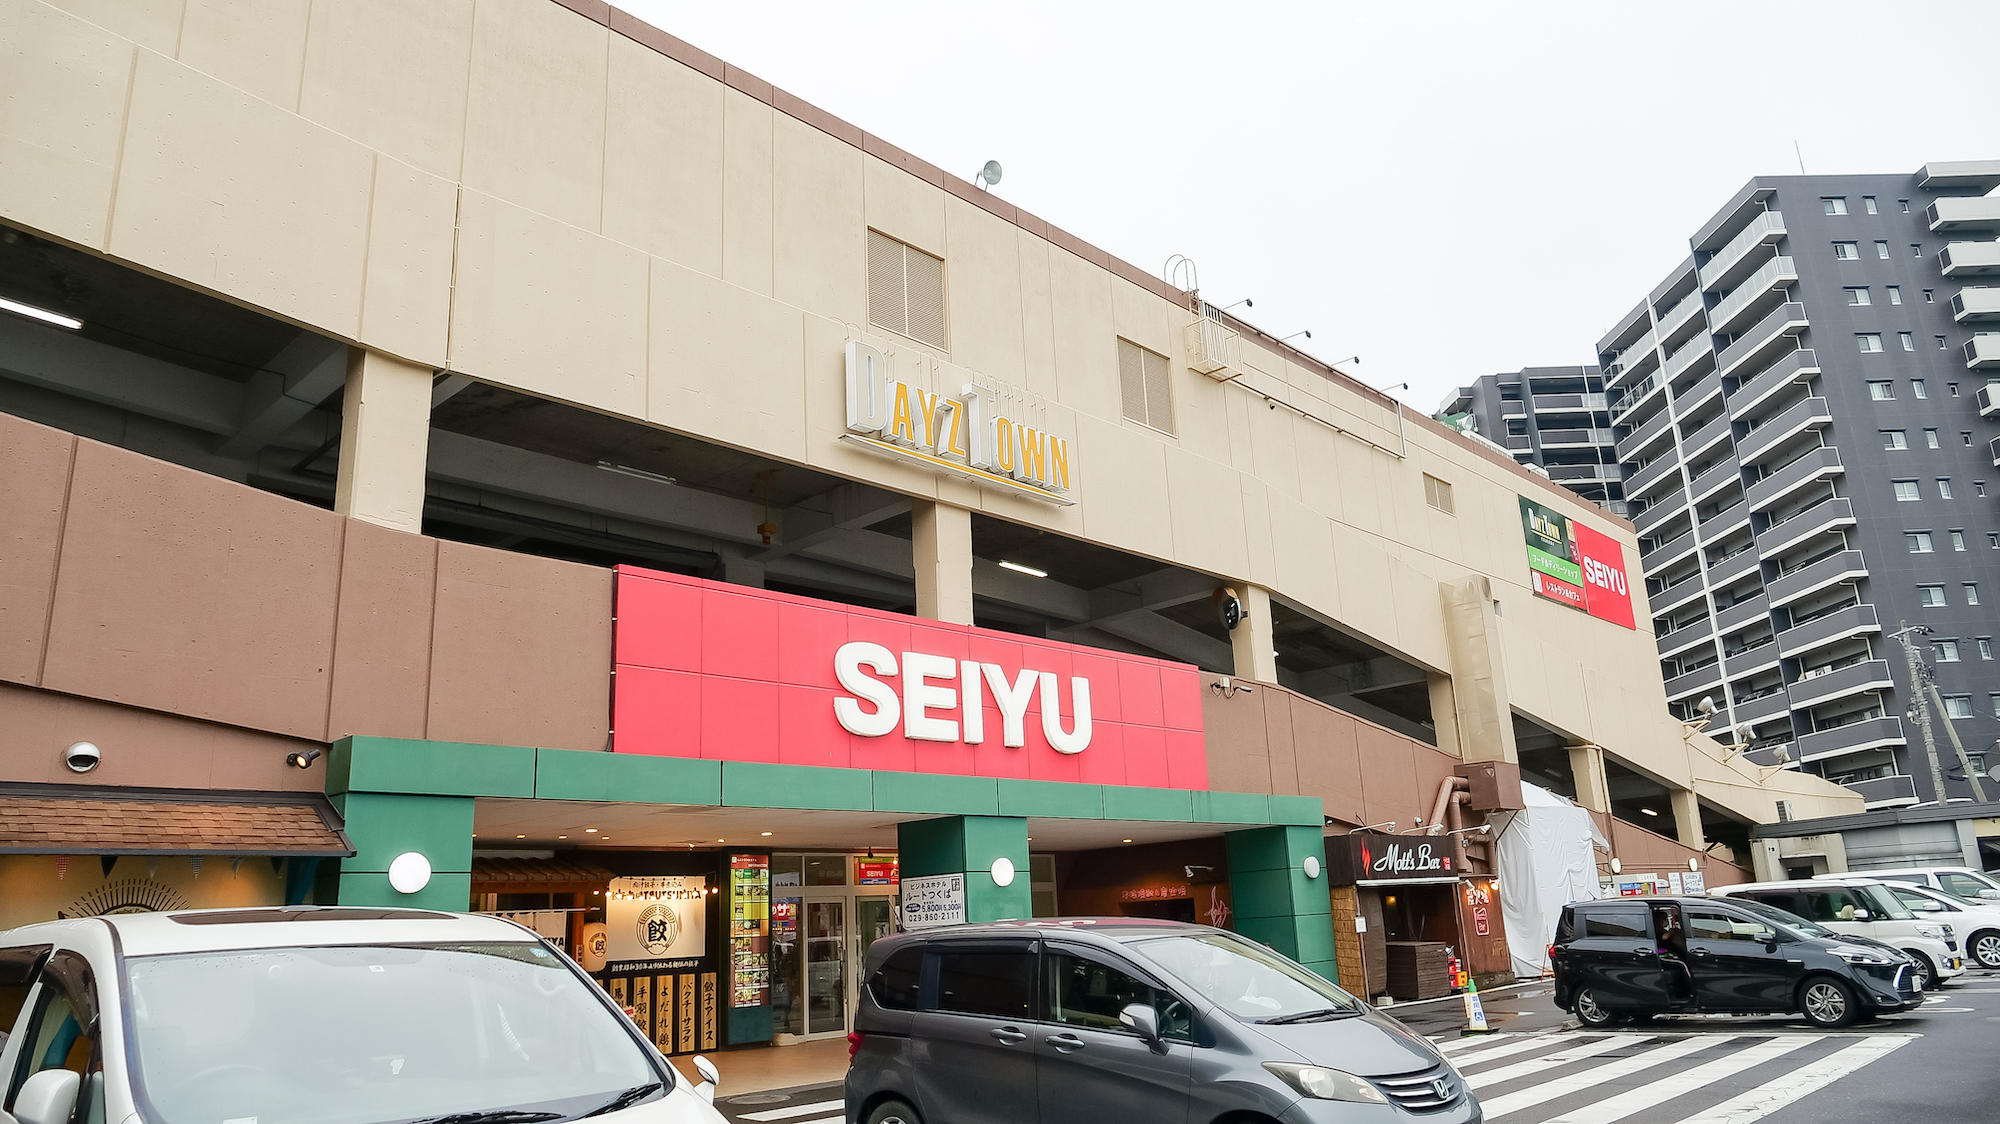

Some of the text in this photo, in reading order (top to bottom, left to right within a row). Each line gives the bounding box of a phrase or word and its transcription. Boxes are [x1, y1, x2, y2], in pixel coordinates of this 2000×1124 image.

[1583, 556, 1626, 596] SEIYU
[834, 641, 1093, 755] SEIYU
[1373, 843, 1415, 875] Mott's
[1416, 843, 1441, 870] Bar
[905, 888, 951, 901] ルートつくば
[910, 881, 947, 890] ビジネスホテル
[648, 919, 667, 942] 餃
[659, 985, 669, 1046] よだれ鶏
[682, 982, 693, 1043] パクチーサラダ
[703, 981, 714, 1041] 餃子アイス
